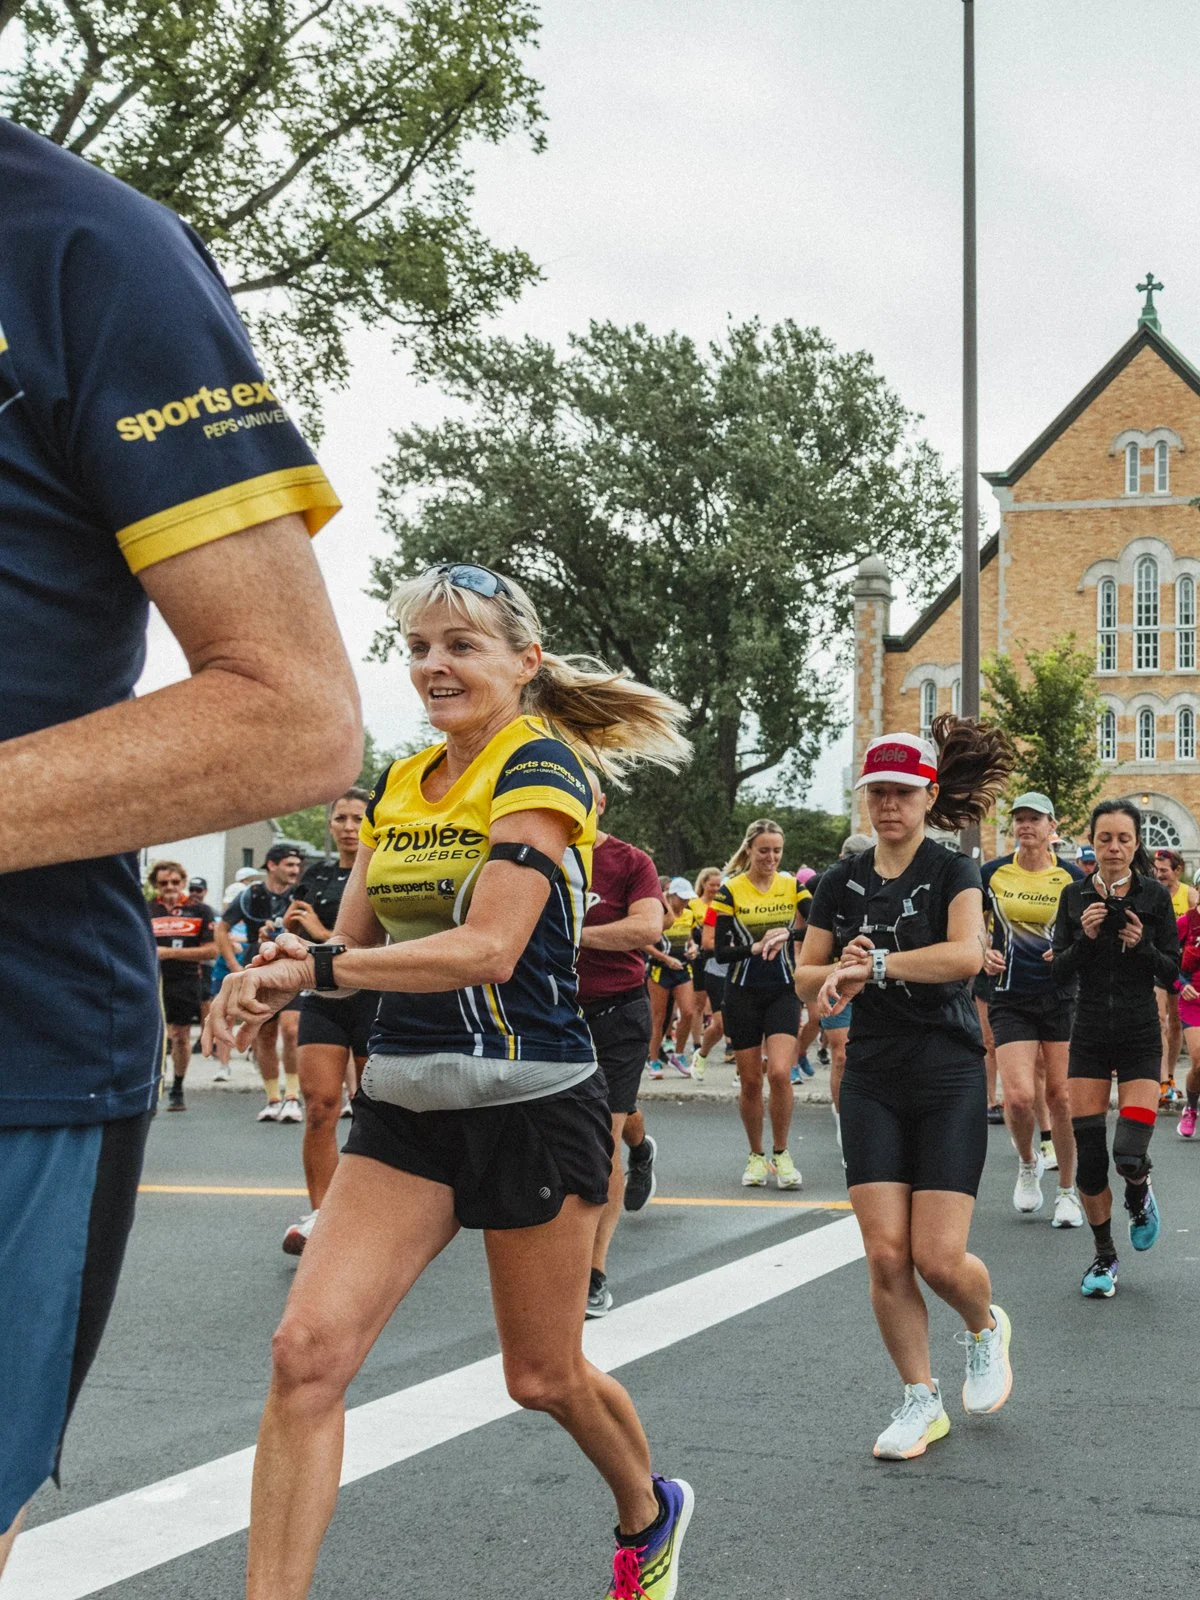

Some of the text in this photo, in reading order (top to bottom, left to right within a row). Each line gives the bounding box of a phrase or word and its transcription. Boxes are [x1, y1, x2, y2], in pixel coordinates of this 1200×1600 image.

[116, 382, 281, 442] sports ex
[404, 849, 480, 864] QUÉBEC
[392, 880, 436, 896] experts
[1003, 890, 1058, 903] la foulée
[738, 906, 750, 915] la
[754, 902, 794, 914] foulée
